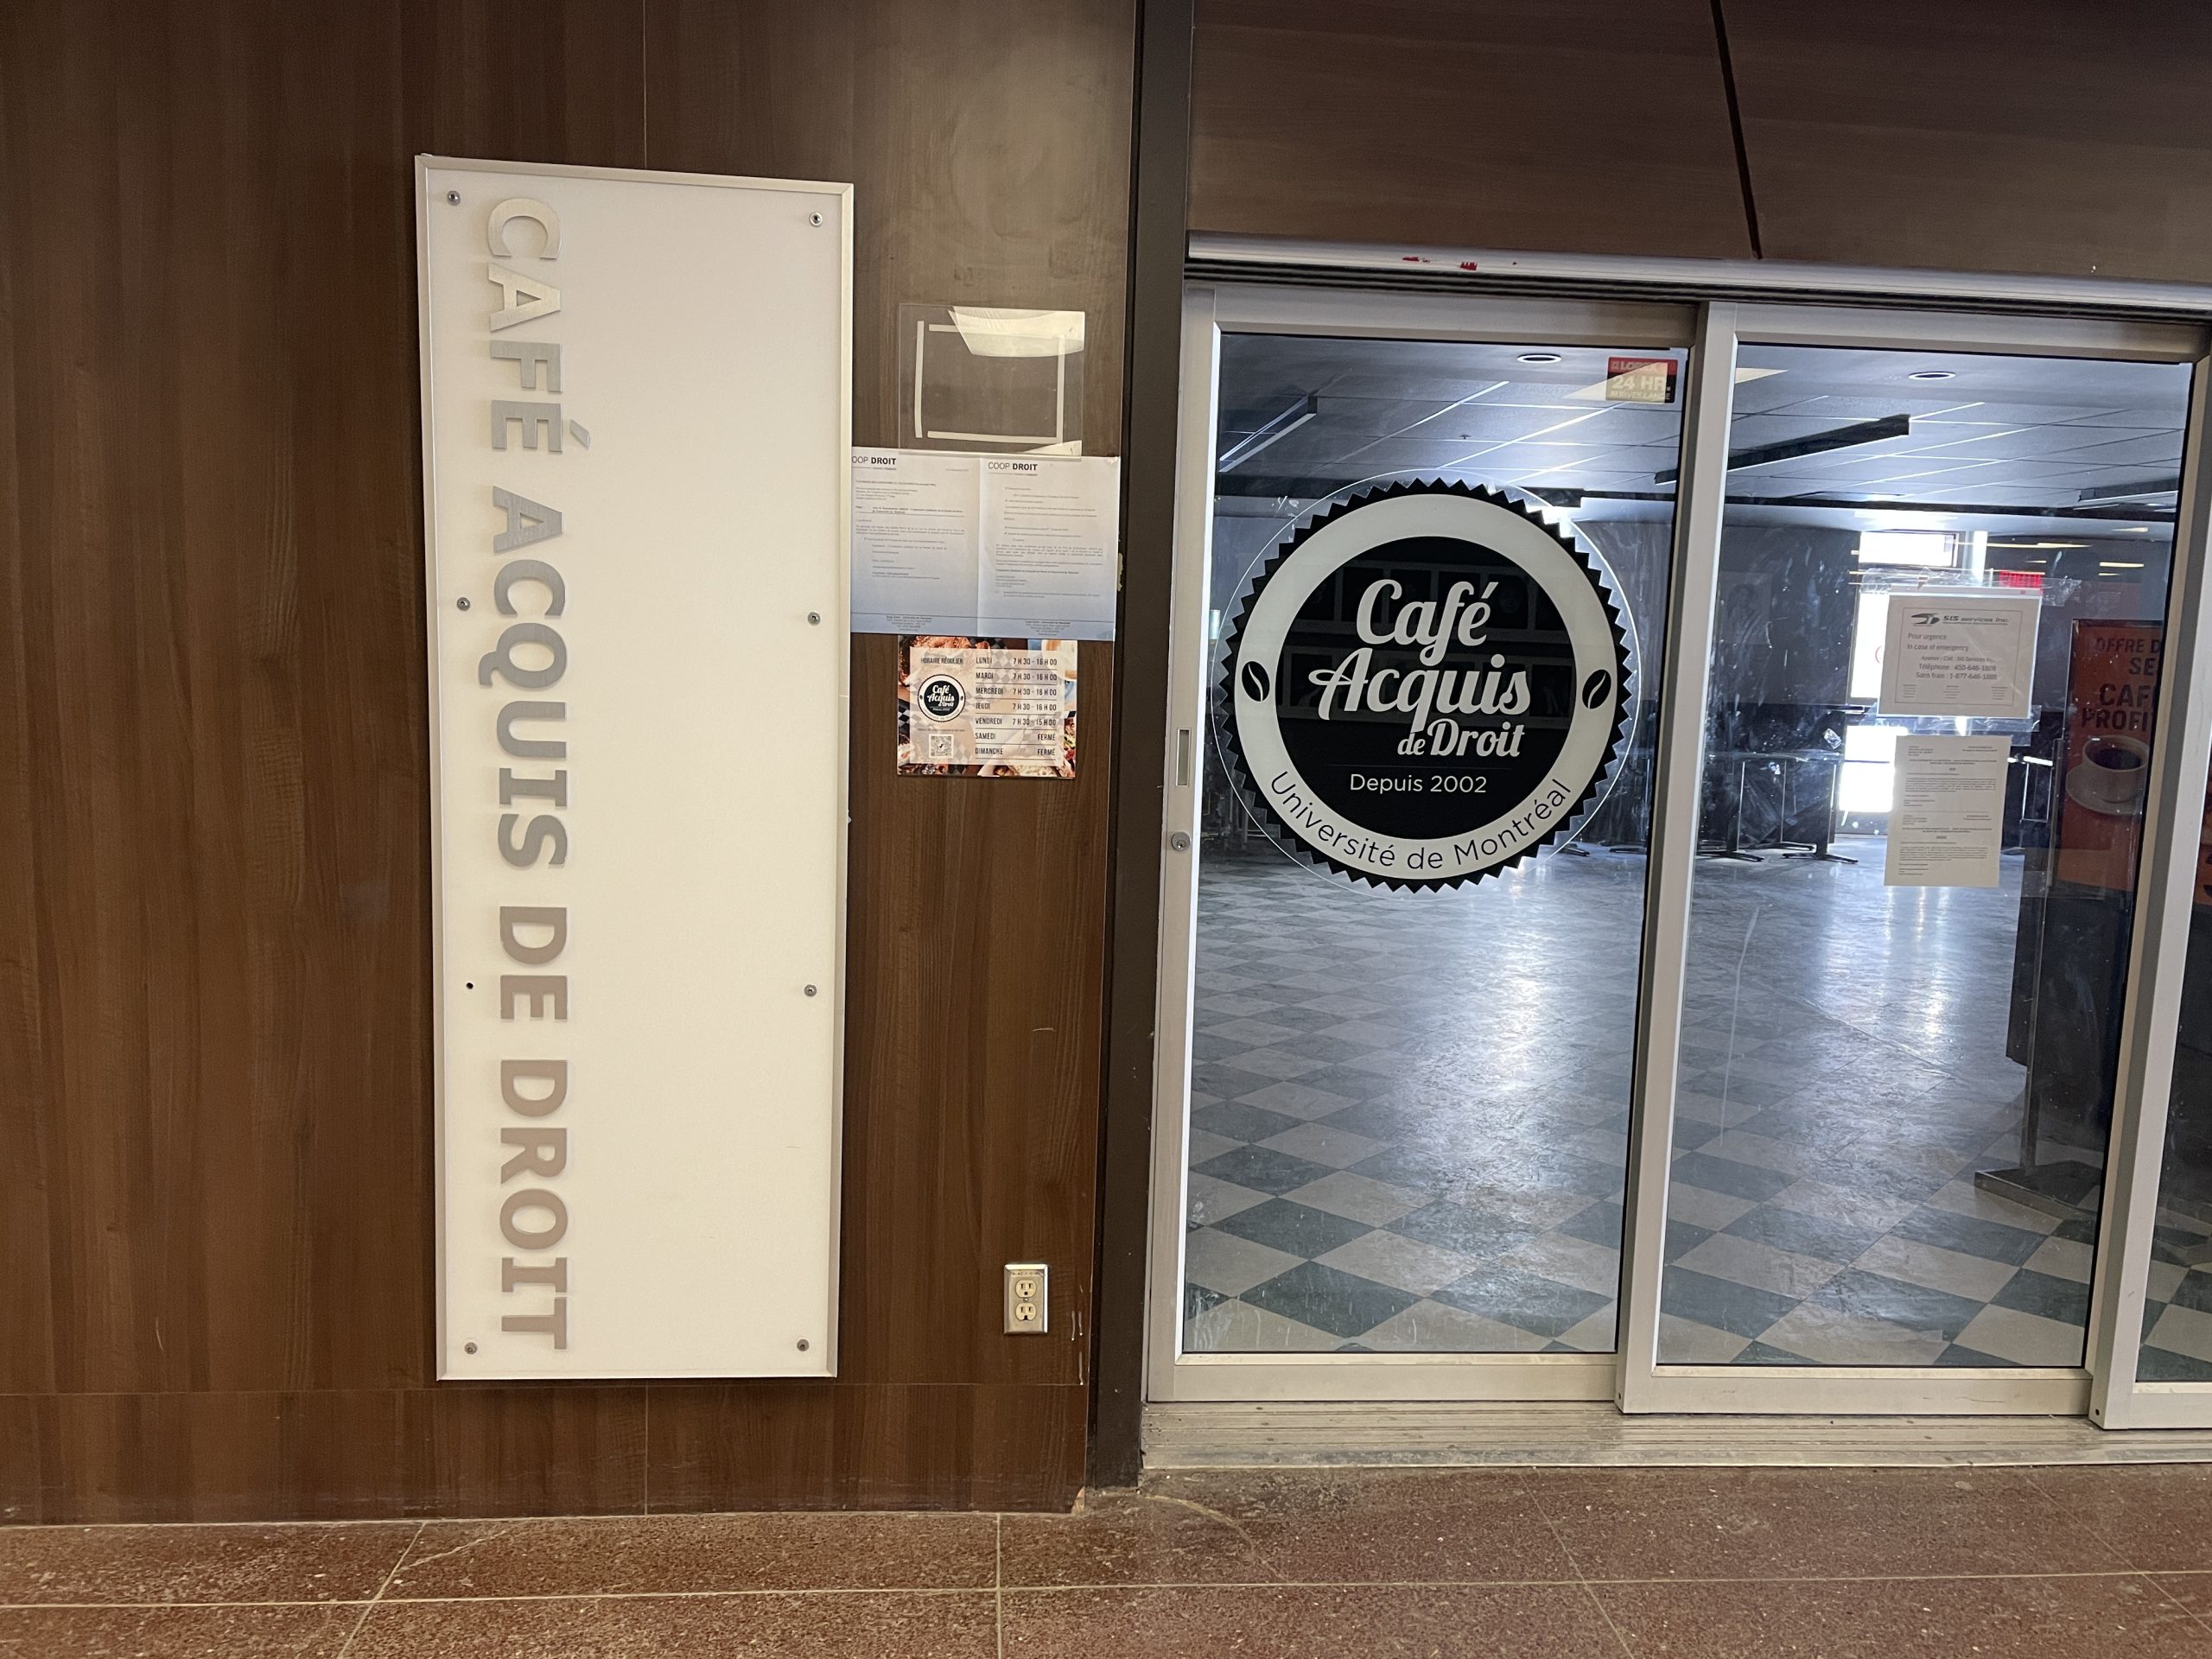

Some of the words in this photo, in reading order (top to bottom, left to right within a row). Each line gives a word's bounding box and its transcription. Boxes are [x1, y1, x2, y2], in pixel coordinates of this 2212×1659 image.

[487, 197, 591, 453] CAFÉ
[1612, 375, 1635, 391] 24
[851, 455, 868, 465] OOP
[870, 457, 897, 466] DROIT
[988, 461, 1010, 470] COOP
[1357, 579, 1499, 666] Café
[2096, 638, 2145, 652] OFFRE
[478, 486, 569, 868] ACQUIS
[927, 693, 955, 704] Acquis
[932, 685, 950, 696] Café
[1308, 648, 1531, 732] Acquis
[2100, 683, 2155, 708] CAF
[2081, 707, 2153, 732] PROFI
[1397, 732, 1426, 756] de
[1427, 717, 1526, 757] Droit
[1350, 774, 1424, 794] Depuis
[1431, 776, 1488, 793] 2002
[1271, 771, 1396, 867] Université
[1407, 848, 1444, 869] de
[1453, 779, 1572, 865] Montréal
[499, 906, 569, 1020] DE
[499, 1059, 569, 1351] DROIT
